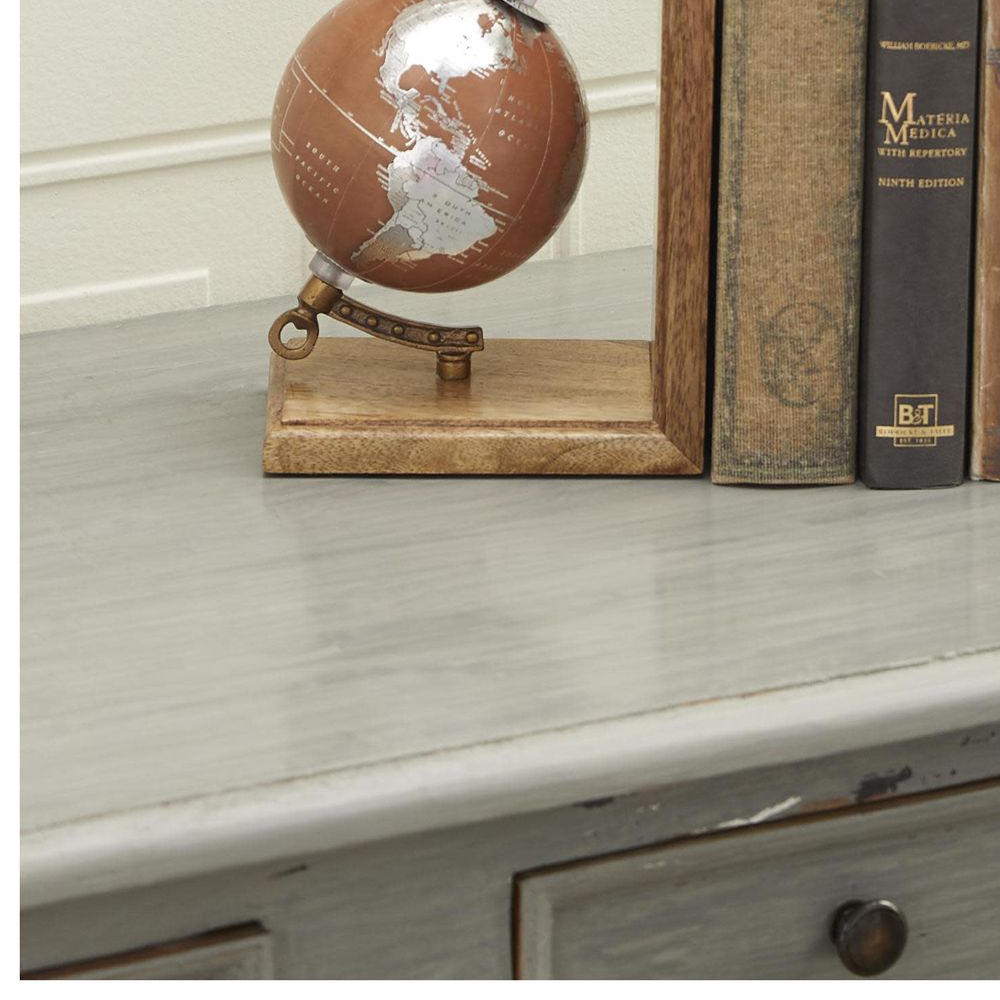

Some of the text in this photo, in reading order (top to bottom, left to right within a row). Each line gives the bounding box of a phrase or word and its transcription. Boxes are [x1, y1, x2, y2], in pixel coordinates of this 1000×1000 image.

[878, 91, 970, 126] MATERIA
[883, 122, 957, 145] MEDICA
[877, 147, 968, 158] WITH REPERTORY
[878, 177, 965, 188] NINTH EDITION
